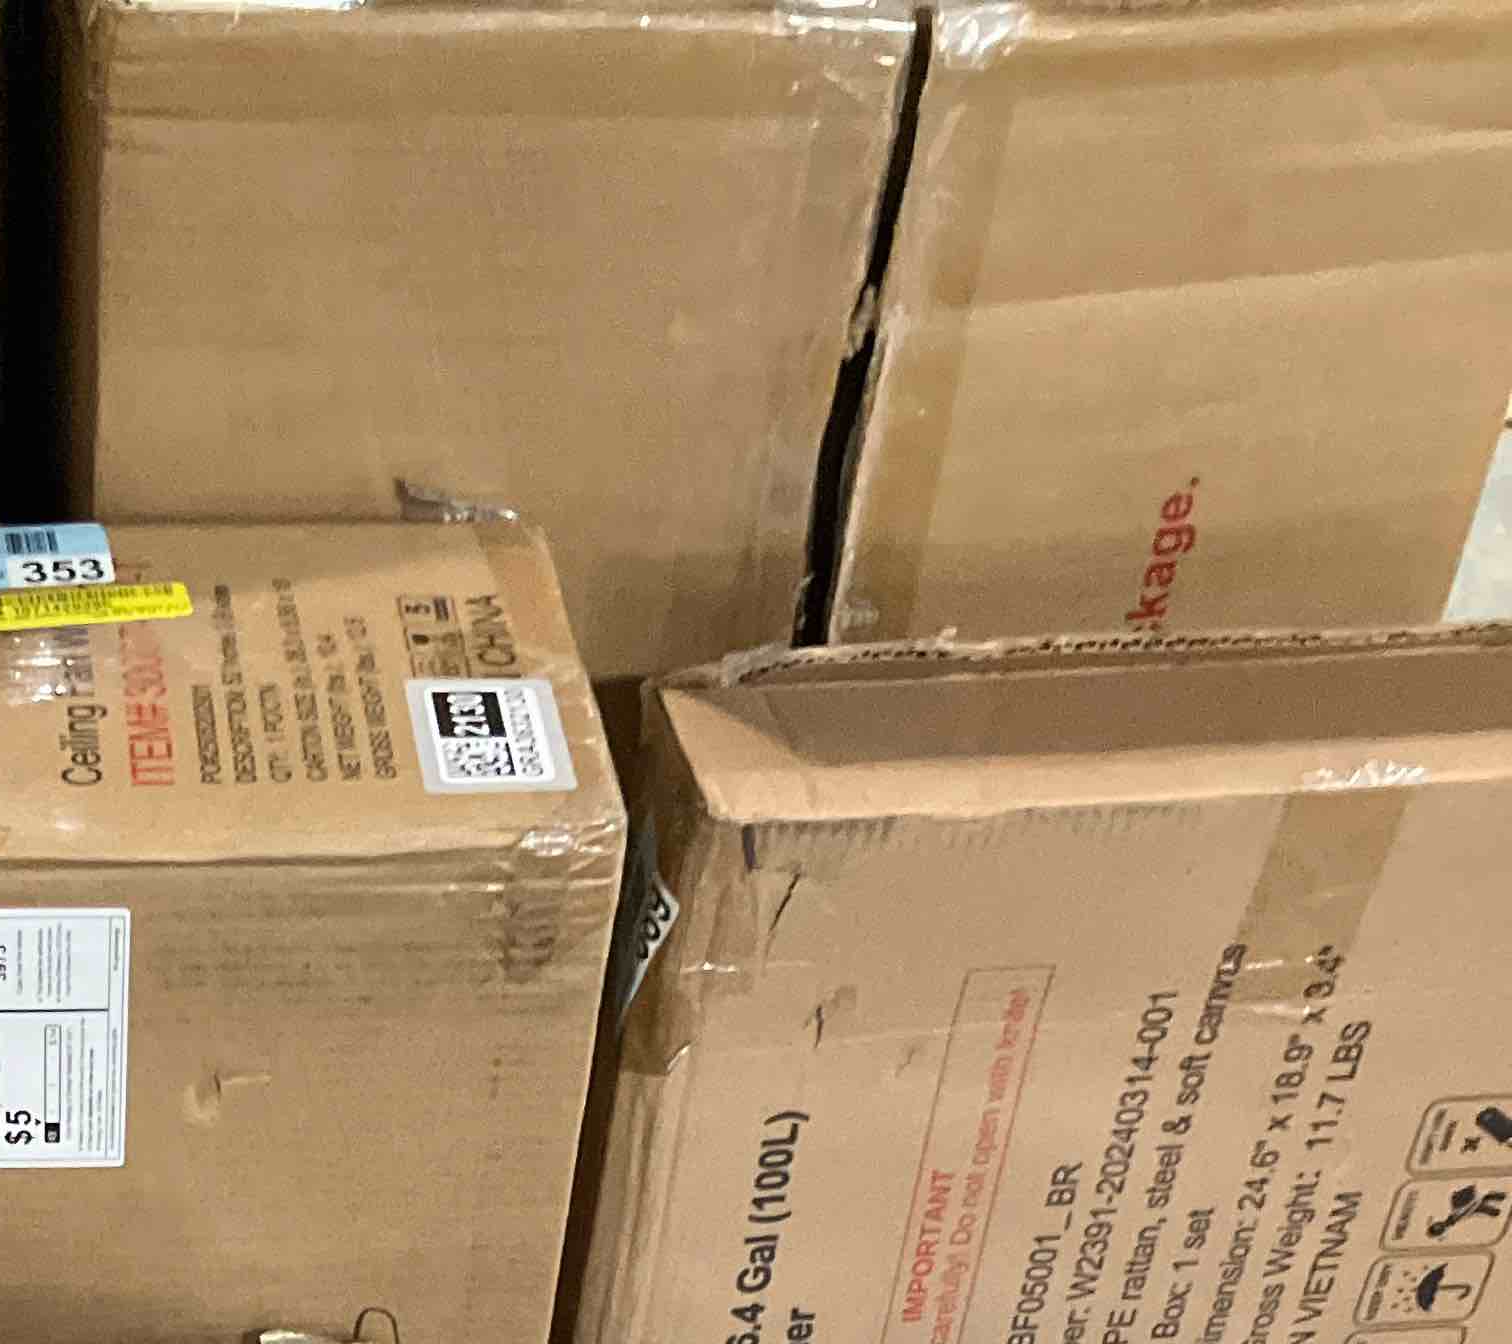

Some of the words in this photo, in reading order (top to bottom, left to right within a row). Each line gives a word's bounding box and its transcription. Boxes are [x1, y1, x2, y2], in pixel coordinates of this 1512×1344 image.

[22, 559, 104, 583] 353
[465, 595, 516, 666] CHINA
[446, 694, 490, 736] 2130
[59, 705, 108, 786] Ceiling
[1175, 1052, 1213, 1106] soft
[4, 1110, 35, 1145] $5
[969, 1108, 1002, 1166] open
[1063, 989, 1178, 1300] W2391-20240314-001
[1162, 1114, 1193, 1135] &
[1261, 1170, 1324, 1278] Weight:
[1304, 1093, 1346, 1153] 11.7
[1325, 1020, 1374, 1082] LBS
[746, 1110, 810, 1223] (100L)
[957, 1171, 987, 1207] not
[1145, 1143, 1186, 1209] steel
[900, 1167, 953, 1323] IMPORTANT
[947, 1212, 978, 1245] Do
[1183, 1206, 1215, 1249] set
[736, 1235, 779, 1295] Gal
[1118, 1216, 1168, 1300] rattan,
[1174, 1257, 1200, 1272] 1
[1290, 1190, 1364, 1327] VIETNAM
[1149, 1280, 1194, 1338] Box:
